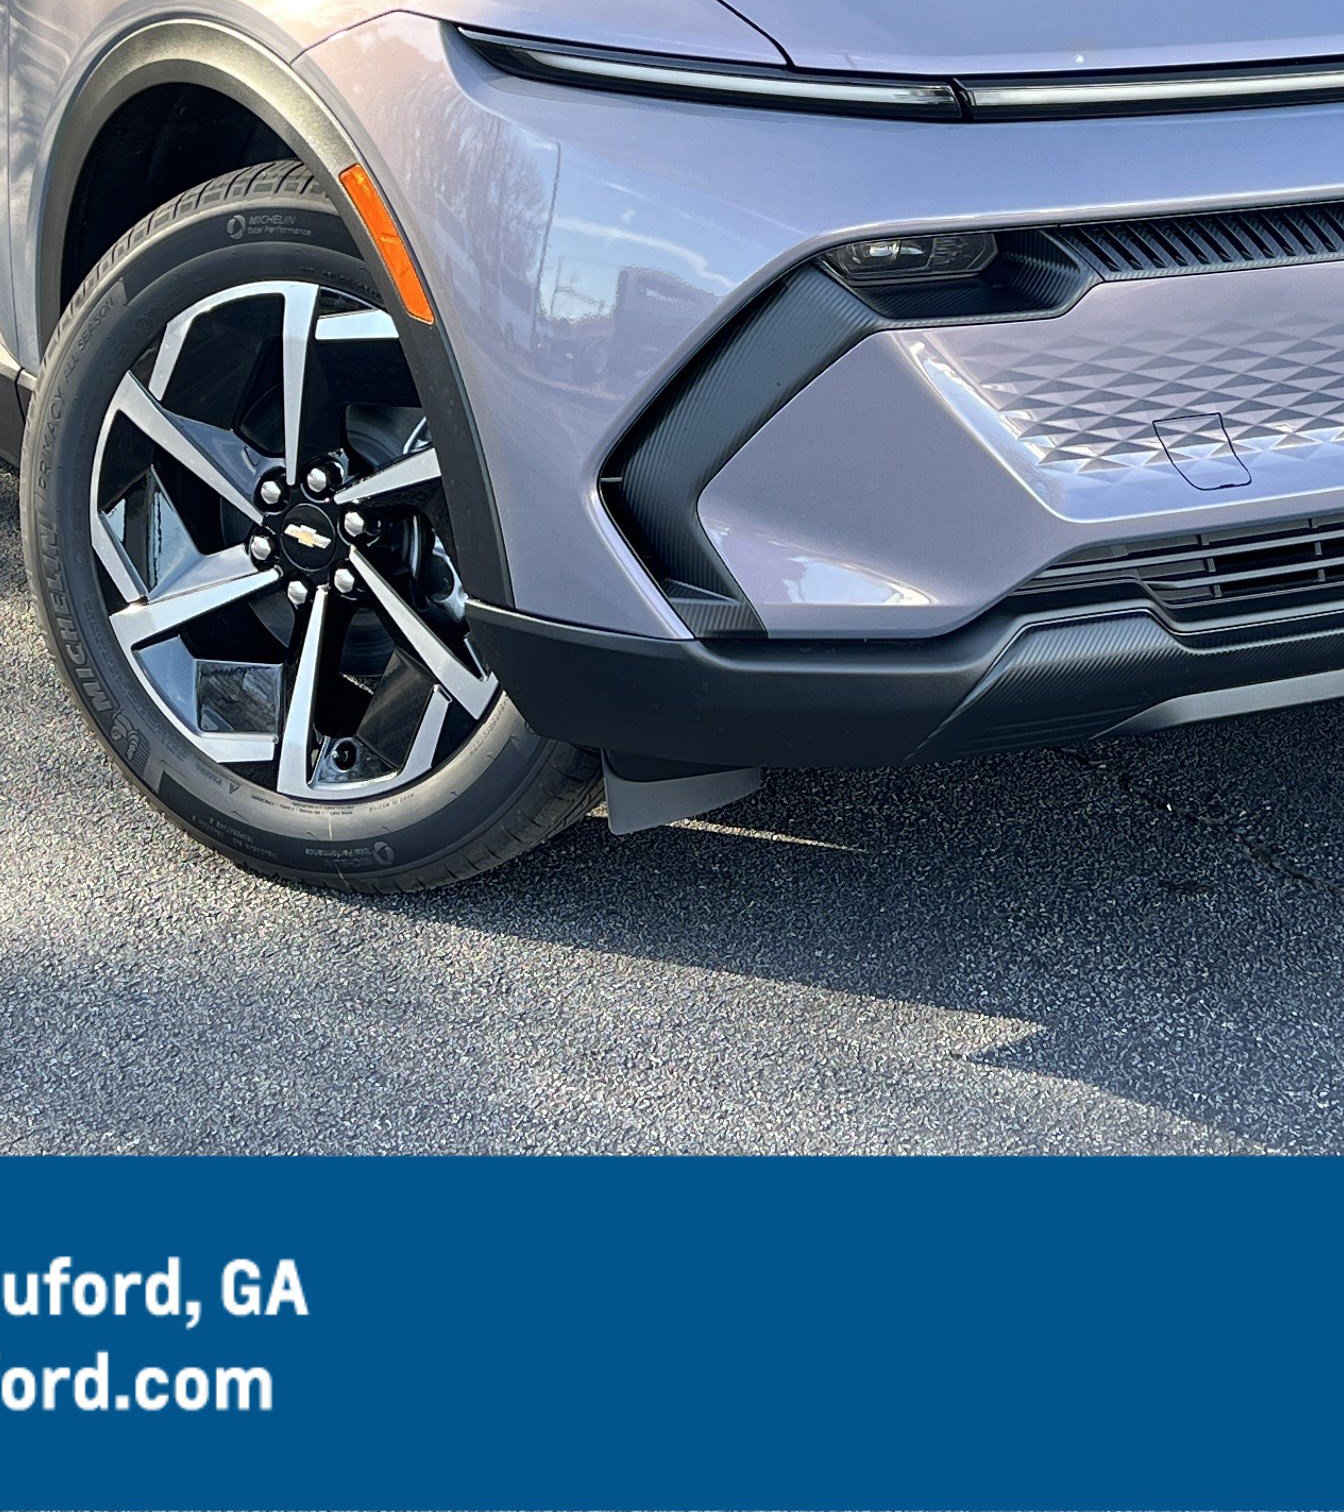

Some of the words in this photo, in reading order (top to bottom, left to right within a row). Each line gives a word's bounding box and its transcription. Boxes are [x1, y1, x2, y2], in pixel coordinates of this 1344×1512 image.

[248, 215, 297, 225] MICHELIN
[264, 226, 312, 237] Performance
[40, 520, 113, 713] MICHELIN
